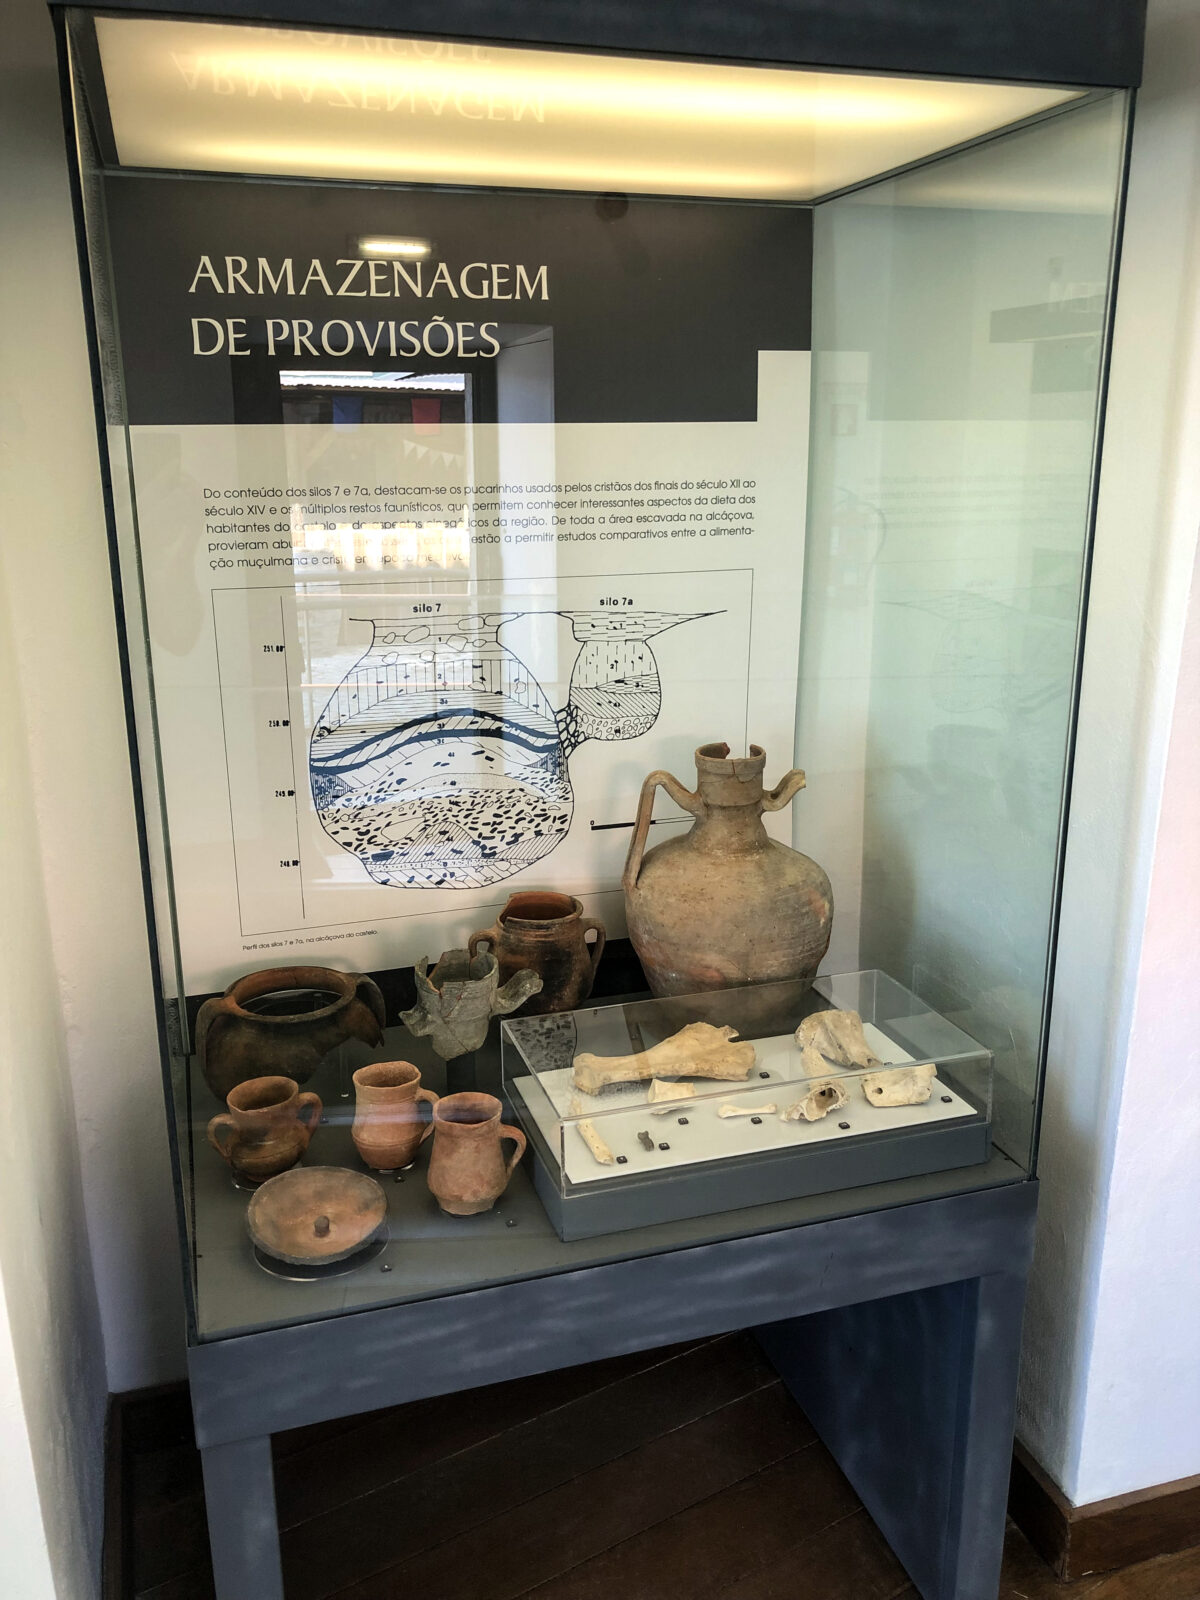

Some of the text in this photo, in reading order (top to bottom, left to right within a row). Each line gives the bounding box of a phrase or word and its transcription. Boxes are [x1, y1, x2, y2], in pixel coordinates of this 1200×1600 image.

[188, 255, 549, 300] ARMAZENAGEM
[191, 315, 500, 359] DE PROVISÕES
[204, 479, 756, 498] Do conteúdo dos silos 7 e 7a, destacam-se os pucarinhos usados pelos cristãos dos finais do século XII ao
[204, 505, 244, 516] século
[246, 504, 266, 515] XIV
[269, 506, 277, 515] e
[280, 506, 293, 515] os
[298, 503, 347, 515] múltiplos
[349, 502, 381, 513] restos
[384, 501, 443, 512] faunísticos,
[472, 500, 524, 512] permitem
[526, 499, 577, 510] conhecer
[580, 498, 645, 509] interessantes
[646, 496, 692, 508] aspectos
[694, 496, 708, 505] da
[710, 495, 736, 505] dieta
[738, 494, 756, 504] dos
[206, 522, 270, 534] habitantes
[273, 521, 290, 532] do
[492, 517, 508, 527] da
[551, 515, 566, 526] De
[569, 515, 595, 525] toda
[598, 516, 606, 524] a
[608, 513, 633, 524] área
[636, 512, 687, 523] escavada
[689, 513, 703, 521] na
[208, 540, 268, 552] provieram
[471, 533, 501, 544] estão
[504, 534, 512, 543] a
[515, 532, 554, 544] permitir
[557, 531, 597, 542] estudos
[599, 529, 668, 541] comparativos
[670, 528, 696, 538] entre
[699, 528, 707, 537] a
[709, 526, 755, 537] alimenta-
[209, 557, 234, 570] ção
[237, 555, 308, 569] muçulmana
[311, 556, 319, 565] e
[412, 603, 441, 613] silo 7
[599, 597, 633, 606] silo 7a
[270, 940, 283, 948] silos
